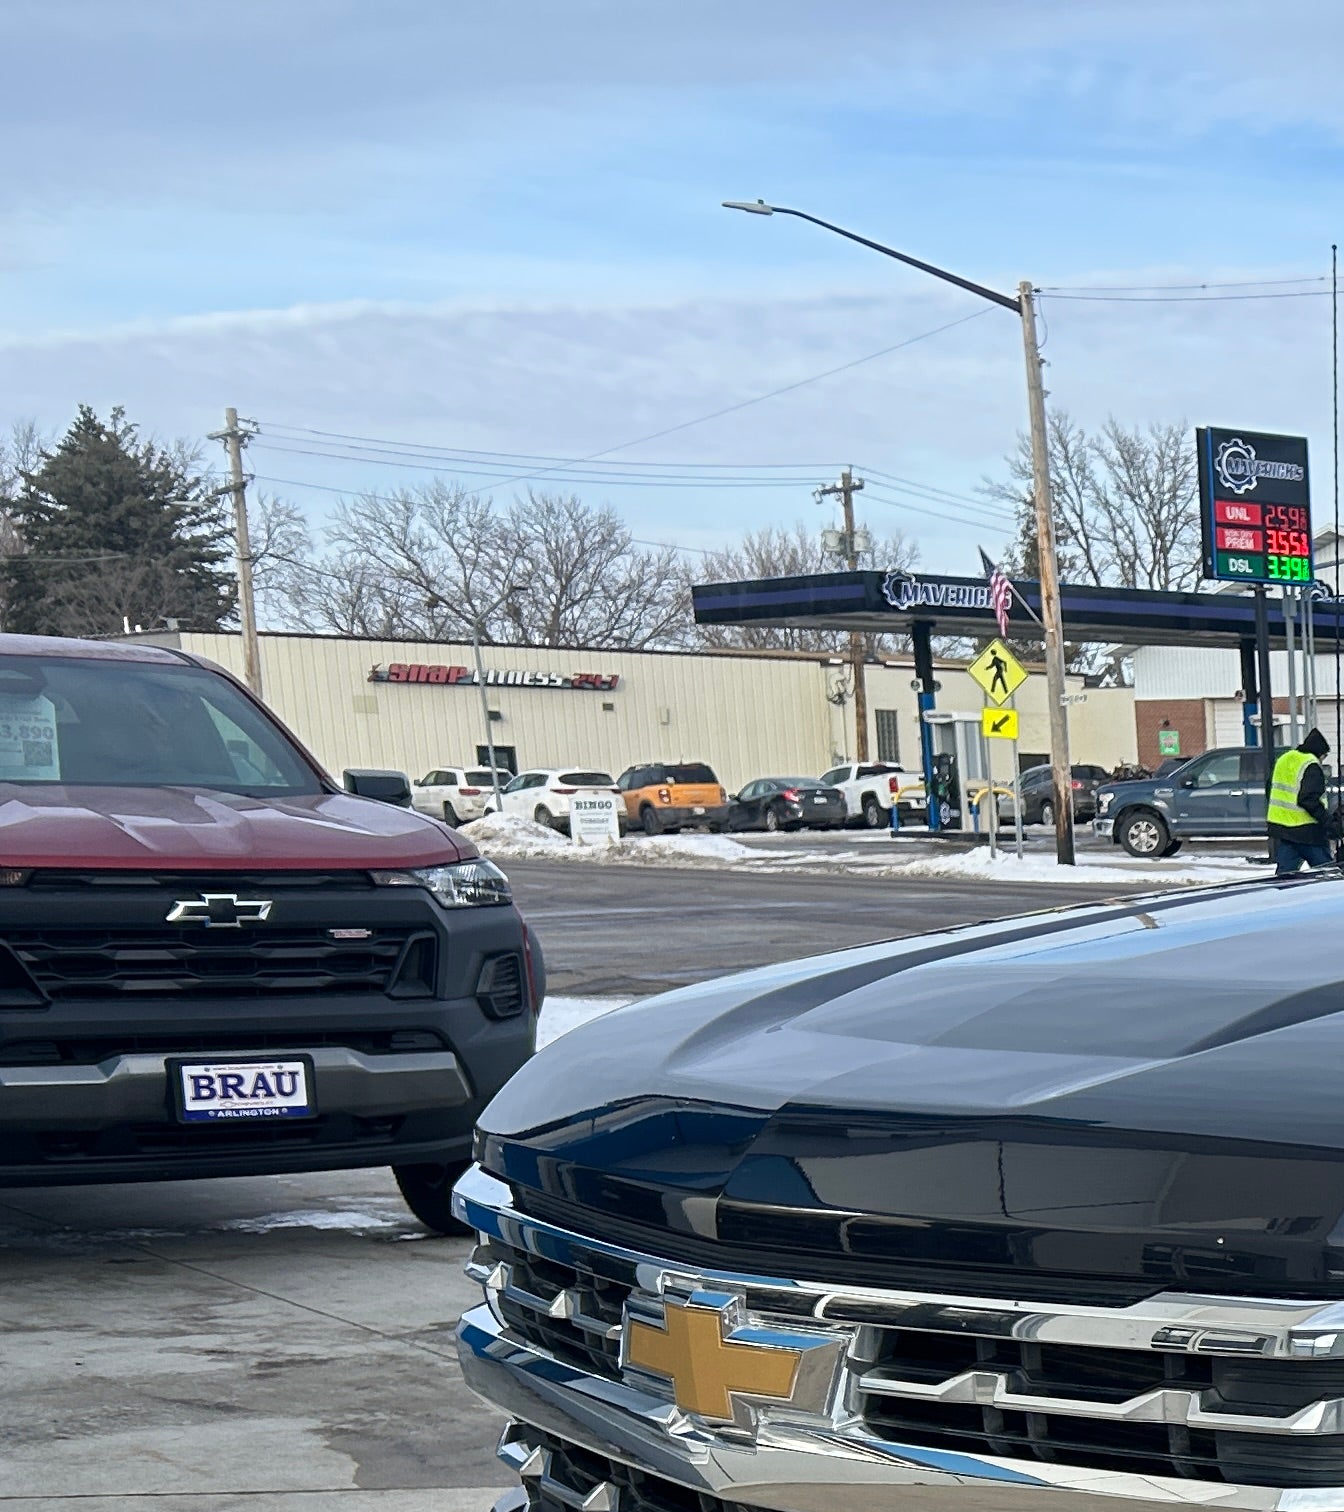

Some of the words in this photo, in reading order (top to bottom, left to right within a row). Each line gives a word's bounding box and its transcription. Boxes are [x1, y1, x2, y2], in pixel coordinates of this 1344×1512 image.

[1225, 505, 1251, 521] UNL
[1228, 558, 1253, 573] DSL
[574, 800, 613, 810] BINGO
[188, 1071, 299, 1101] BRAU
[217, 1108, 279, 1117] ARLINGTON
